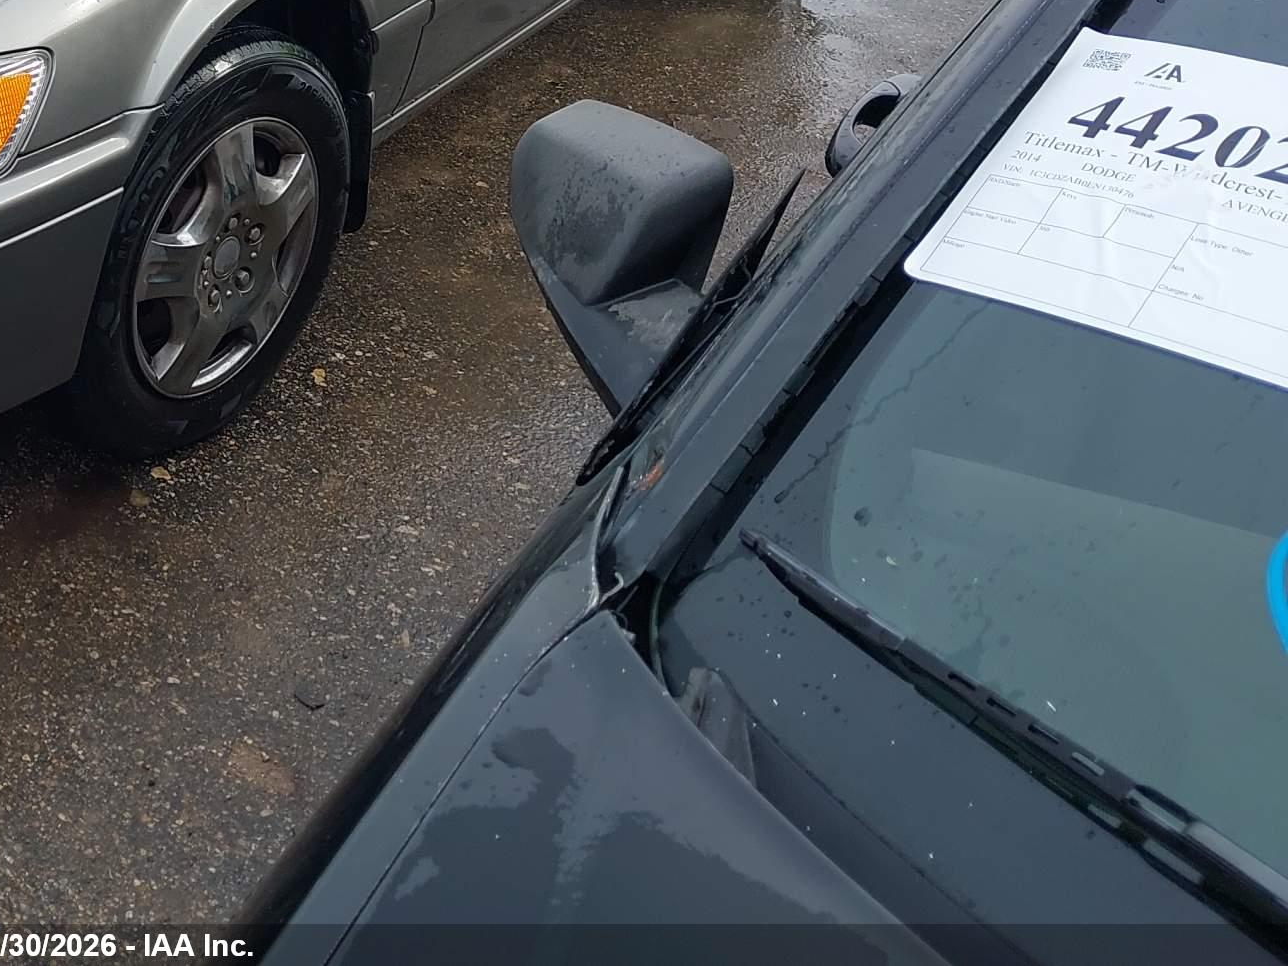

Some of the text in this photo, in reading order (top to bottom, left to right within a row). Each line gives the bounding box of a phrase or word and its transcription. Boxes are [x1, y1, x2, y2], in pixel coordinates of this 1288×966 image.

[1025, 131, 1105, 158] Titlemax
[1011, 149, 1043, 163] 2014
[1080, 162, 1137, 183] DODGE
